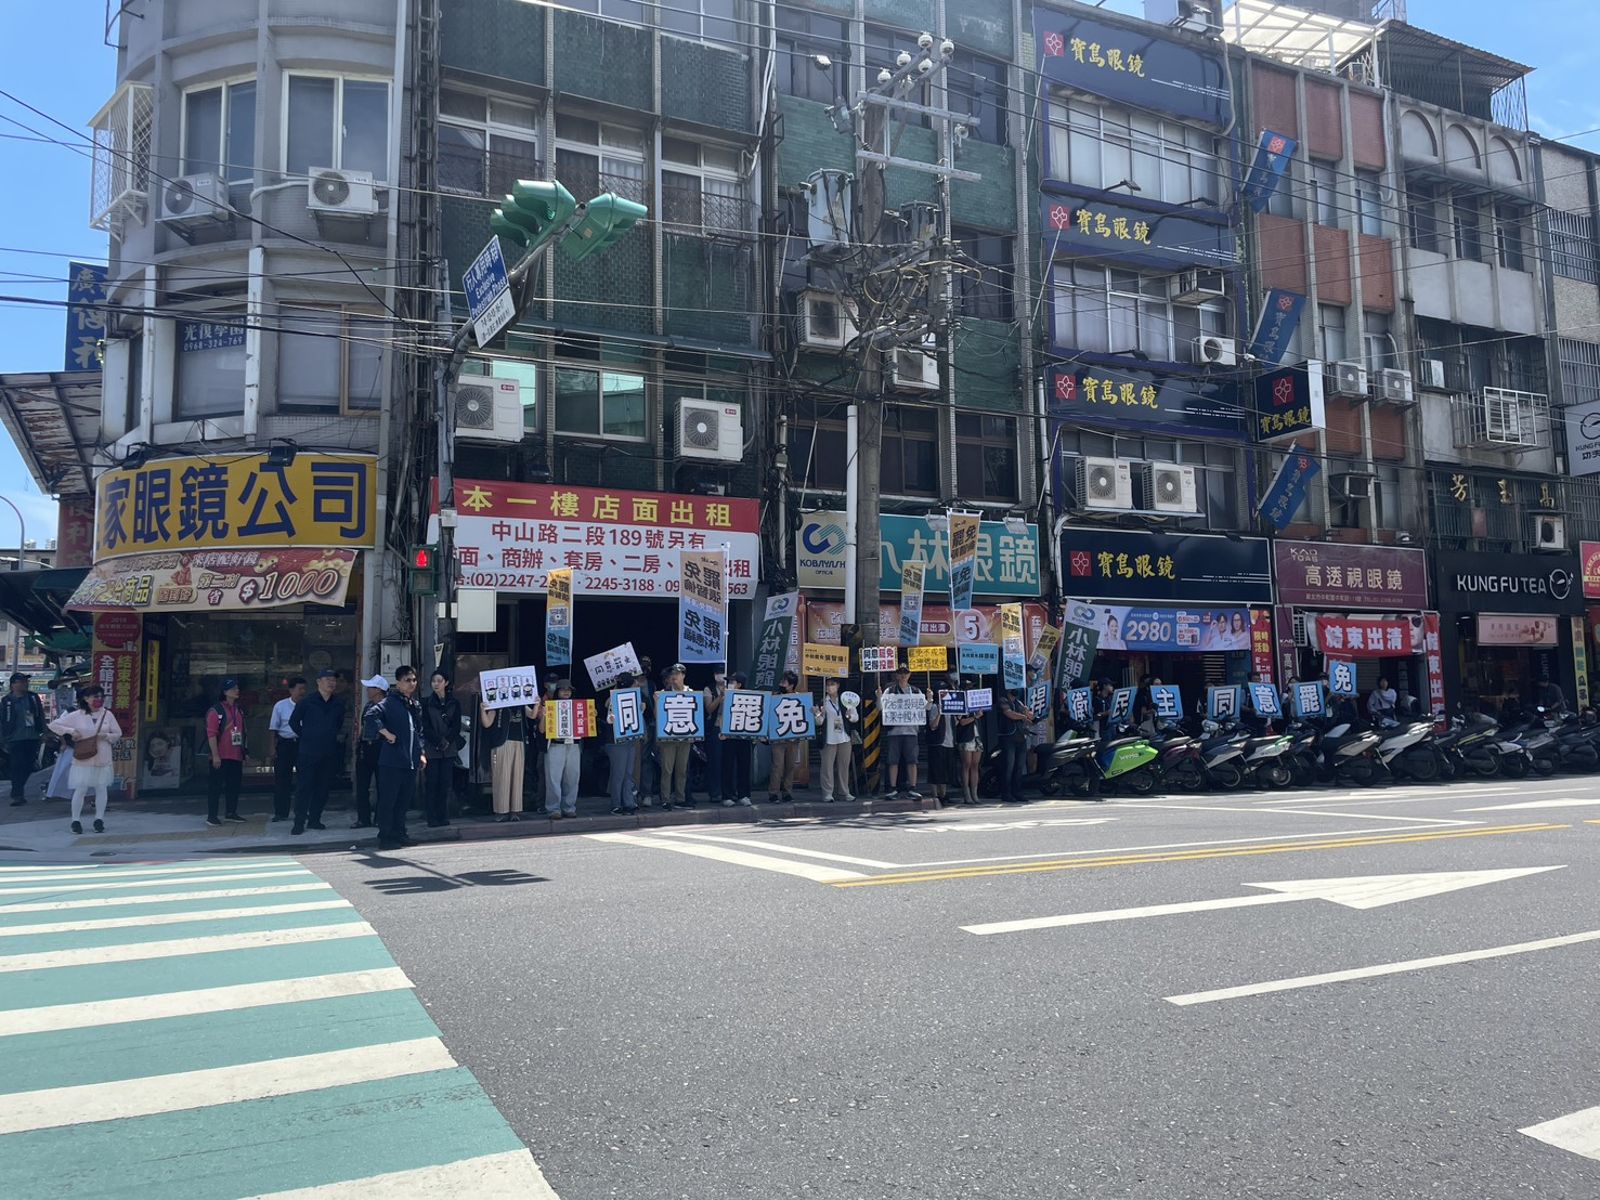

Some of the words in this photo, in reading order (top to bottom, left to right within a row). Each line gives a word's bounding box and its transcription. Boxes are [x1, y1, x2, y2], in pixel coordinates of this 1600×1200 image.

[1070, 38, 1145, 78] 寶島眼鏡
[1076, 209, 1151, 246] 寶島眼鏡
[1082, 377, 1158, 409] 寶島眼鏡
[1260, 405, 1311, 434] 寶島眼鏡
[95, 462, 366, 550] 家眼鏡公司
[462, 485, 732, 527] 本一樓店面出租
[491, 520, 707, 550] 中山路二段189號另有
[799, 559, 846, 569] KOBAYASH
[1097, 551, 1176, 581] 寶島眼鏡
[1304, 564, 1403, 591] 高透視眼鏡
[240, 569, 338, 602] $1000
[585, 577, 655, 593] 2245-3188
[1521, 577, 1548, 593] TEA
[963, 615, 980, 640] 5
[1125, 620, 1172, 642] 2980
[1324, 624, 1404, 651] 結束出清
[117, 655, 132, 710] 結束營業
